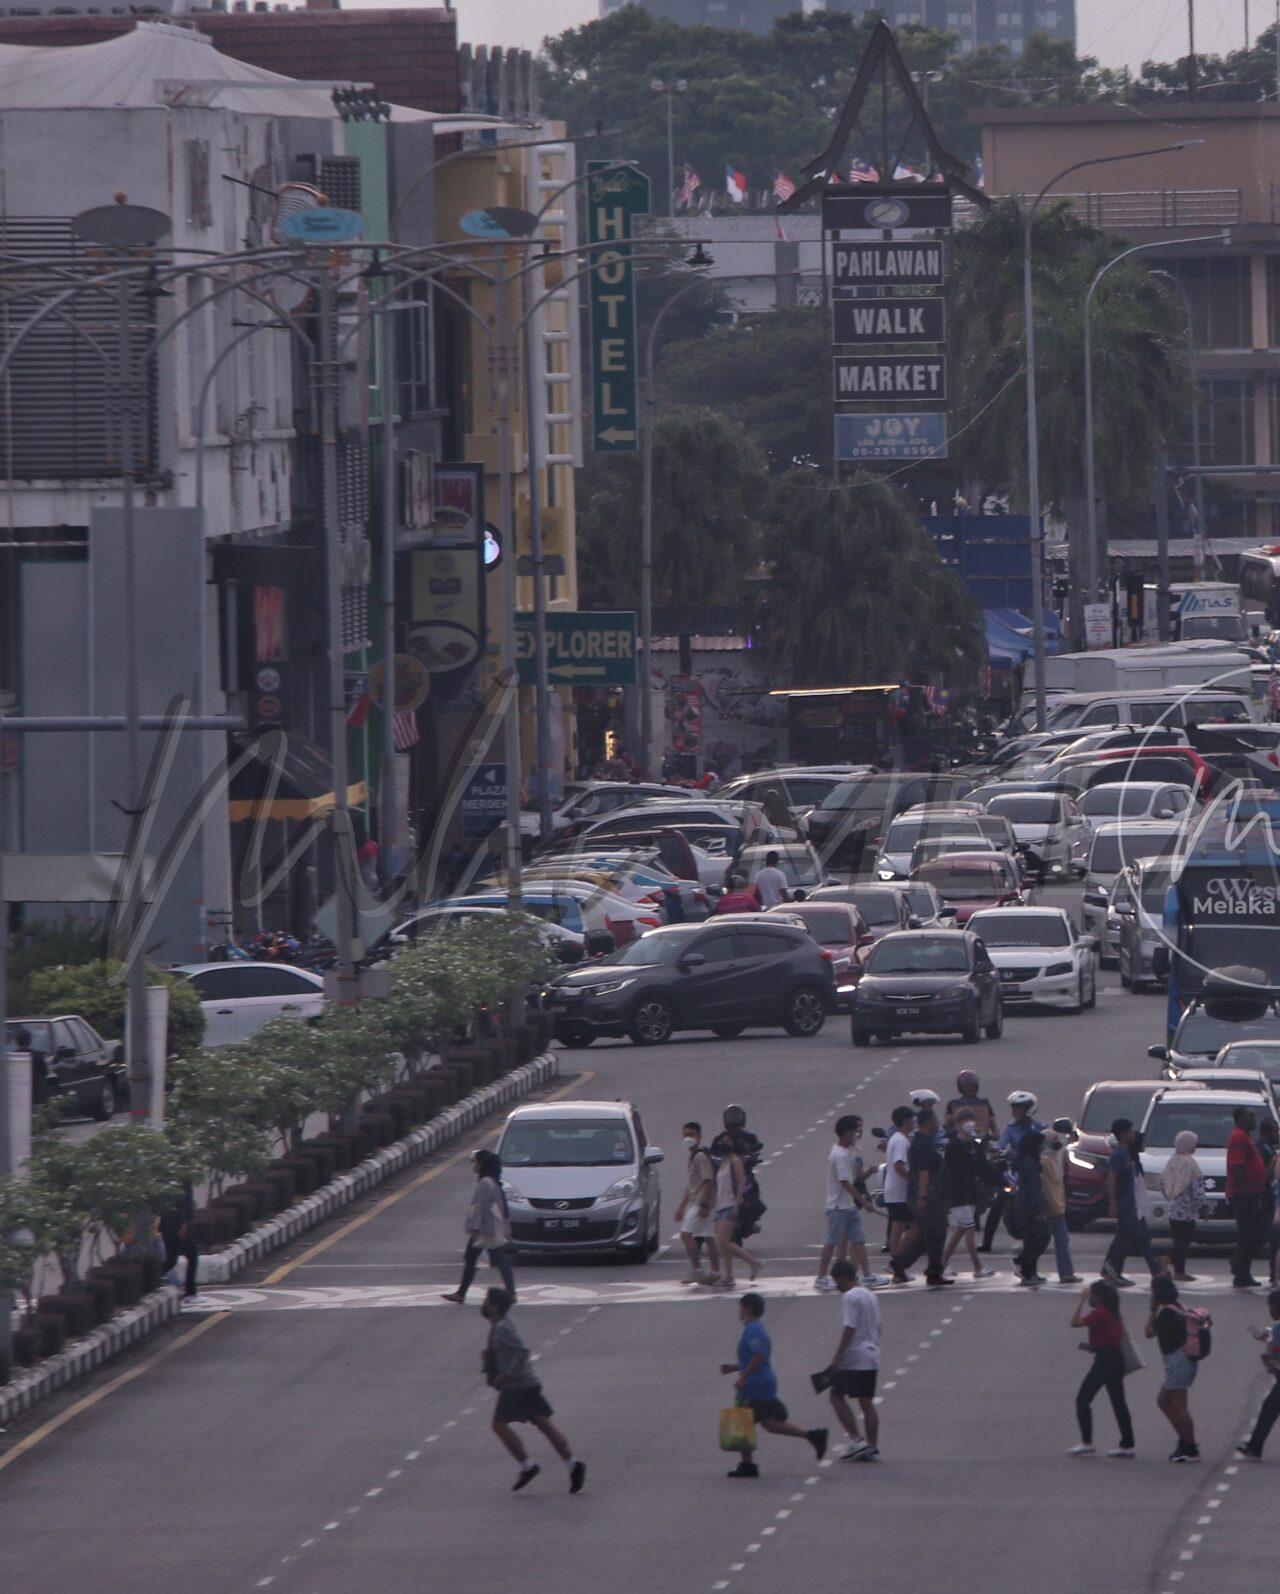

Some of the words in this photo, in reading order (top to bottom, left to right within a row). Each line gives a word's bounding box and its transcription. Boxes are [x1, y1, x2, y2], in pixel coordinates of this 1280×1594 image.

[837, 250, 939, 277] PAHLAWAN
[597, 206, 627, 415] HOTEL
[853, 308, 924, 334] WALK
[839, 365, 940, 391] MARKET
